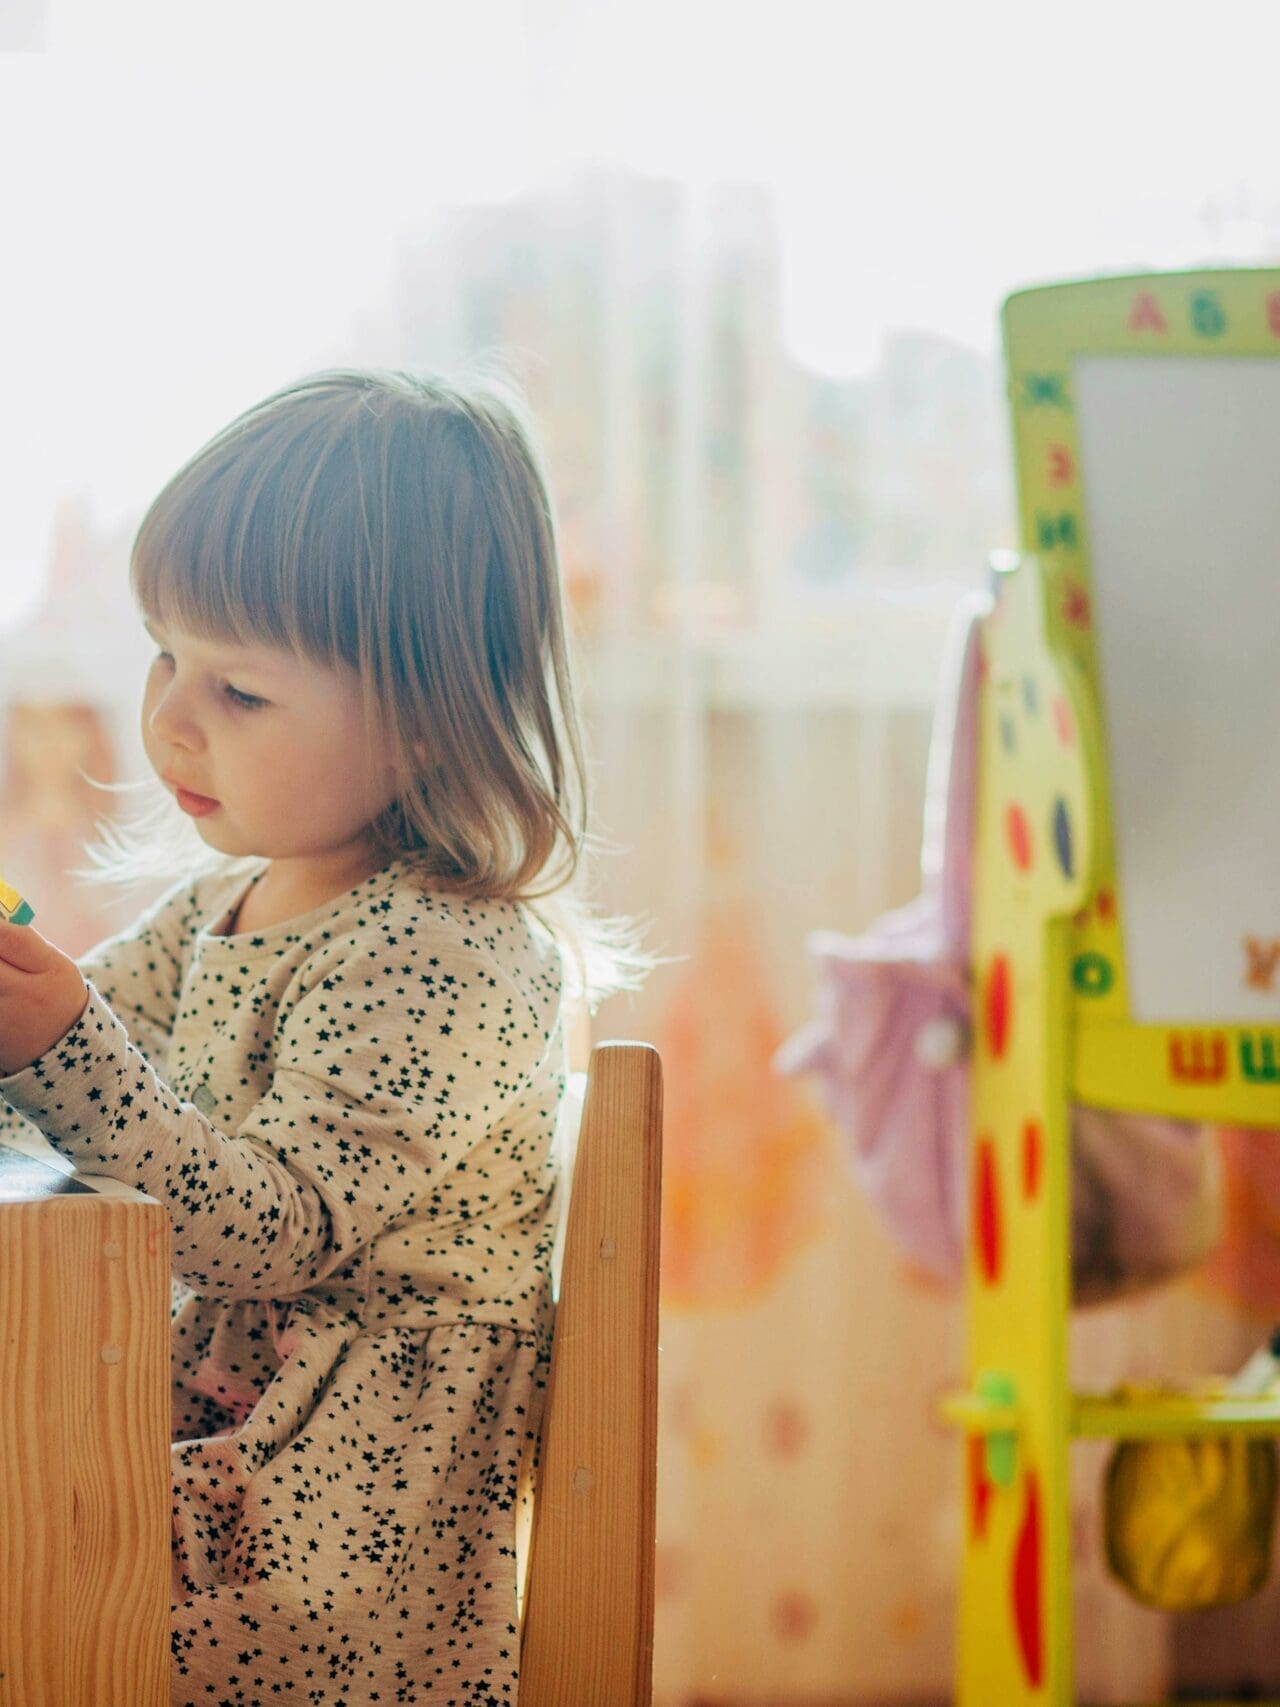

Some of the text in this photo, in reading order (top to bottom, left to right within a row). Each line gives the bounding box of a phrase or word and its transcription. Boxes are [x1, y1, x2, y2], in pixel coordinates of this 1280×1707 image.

[1127, 290, 1169, 337] А
[1070, 949, 1115, 998] О
[1167, 1030, 1228, 1086] Ш
